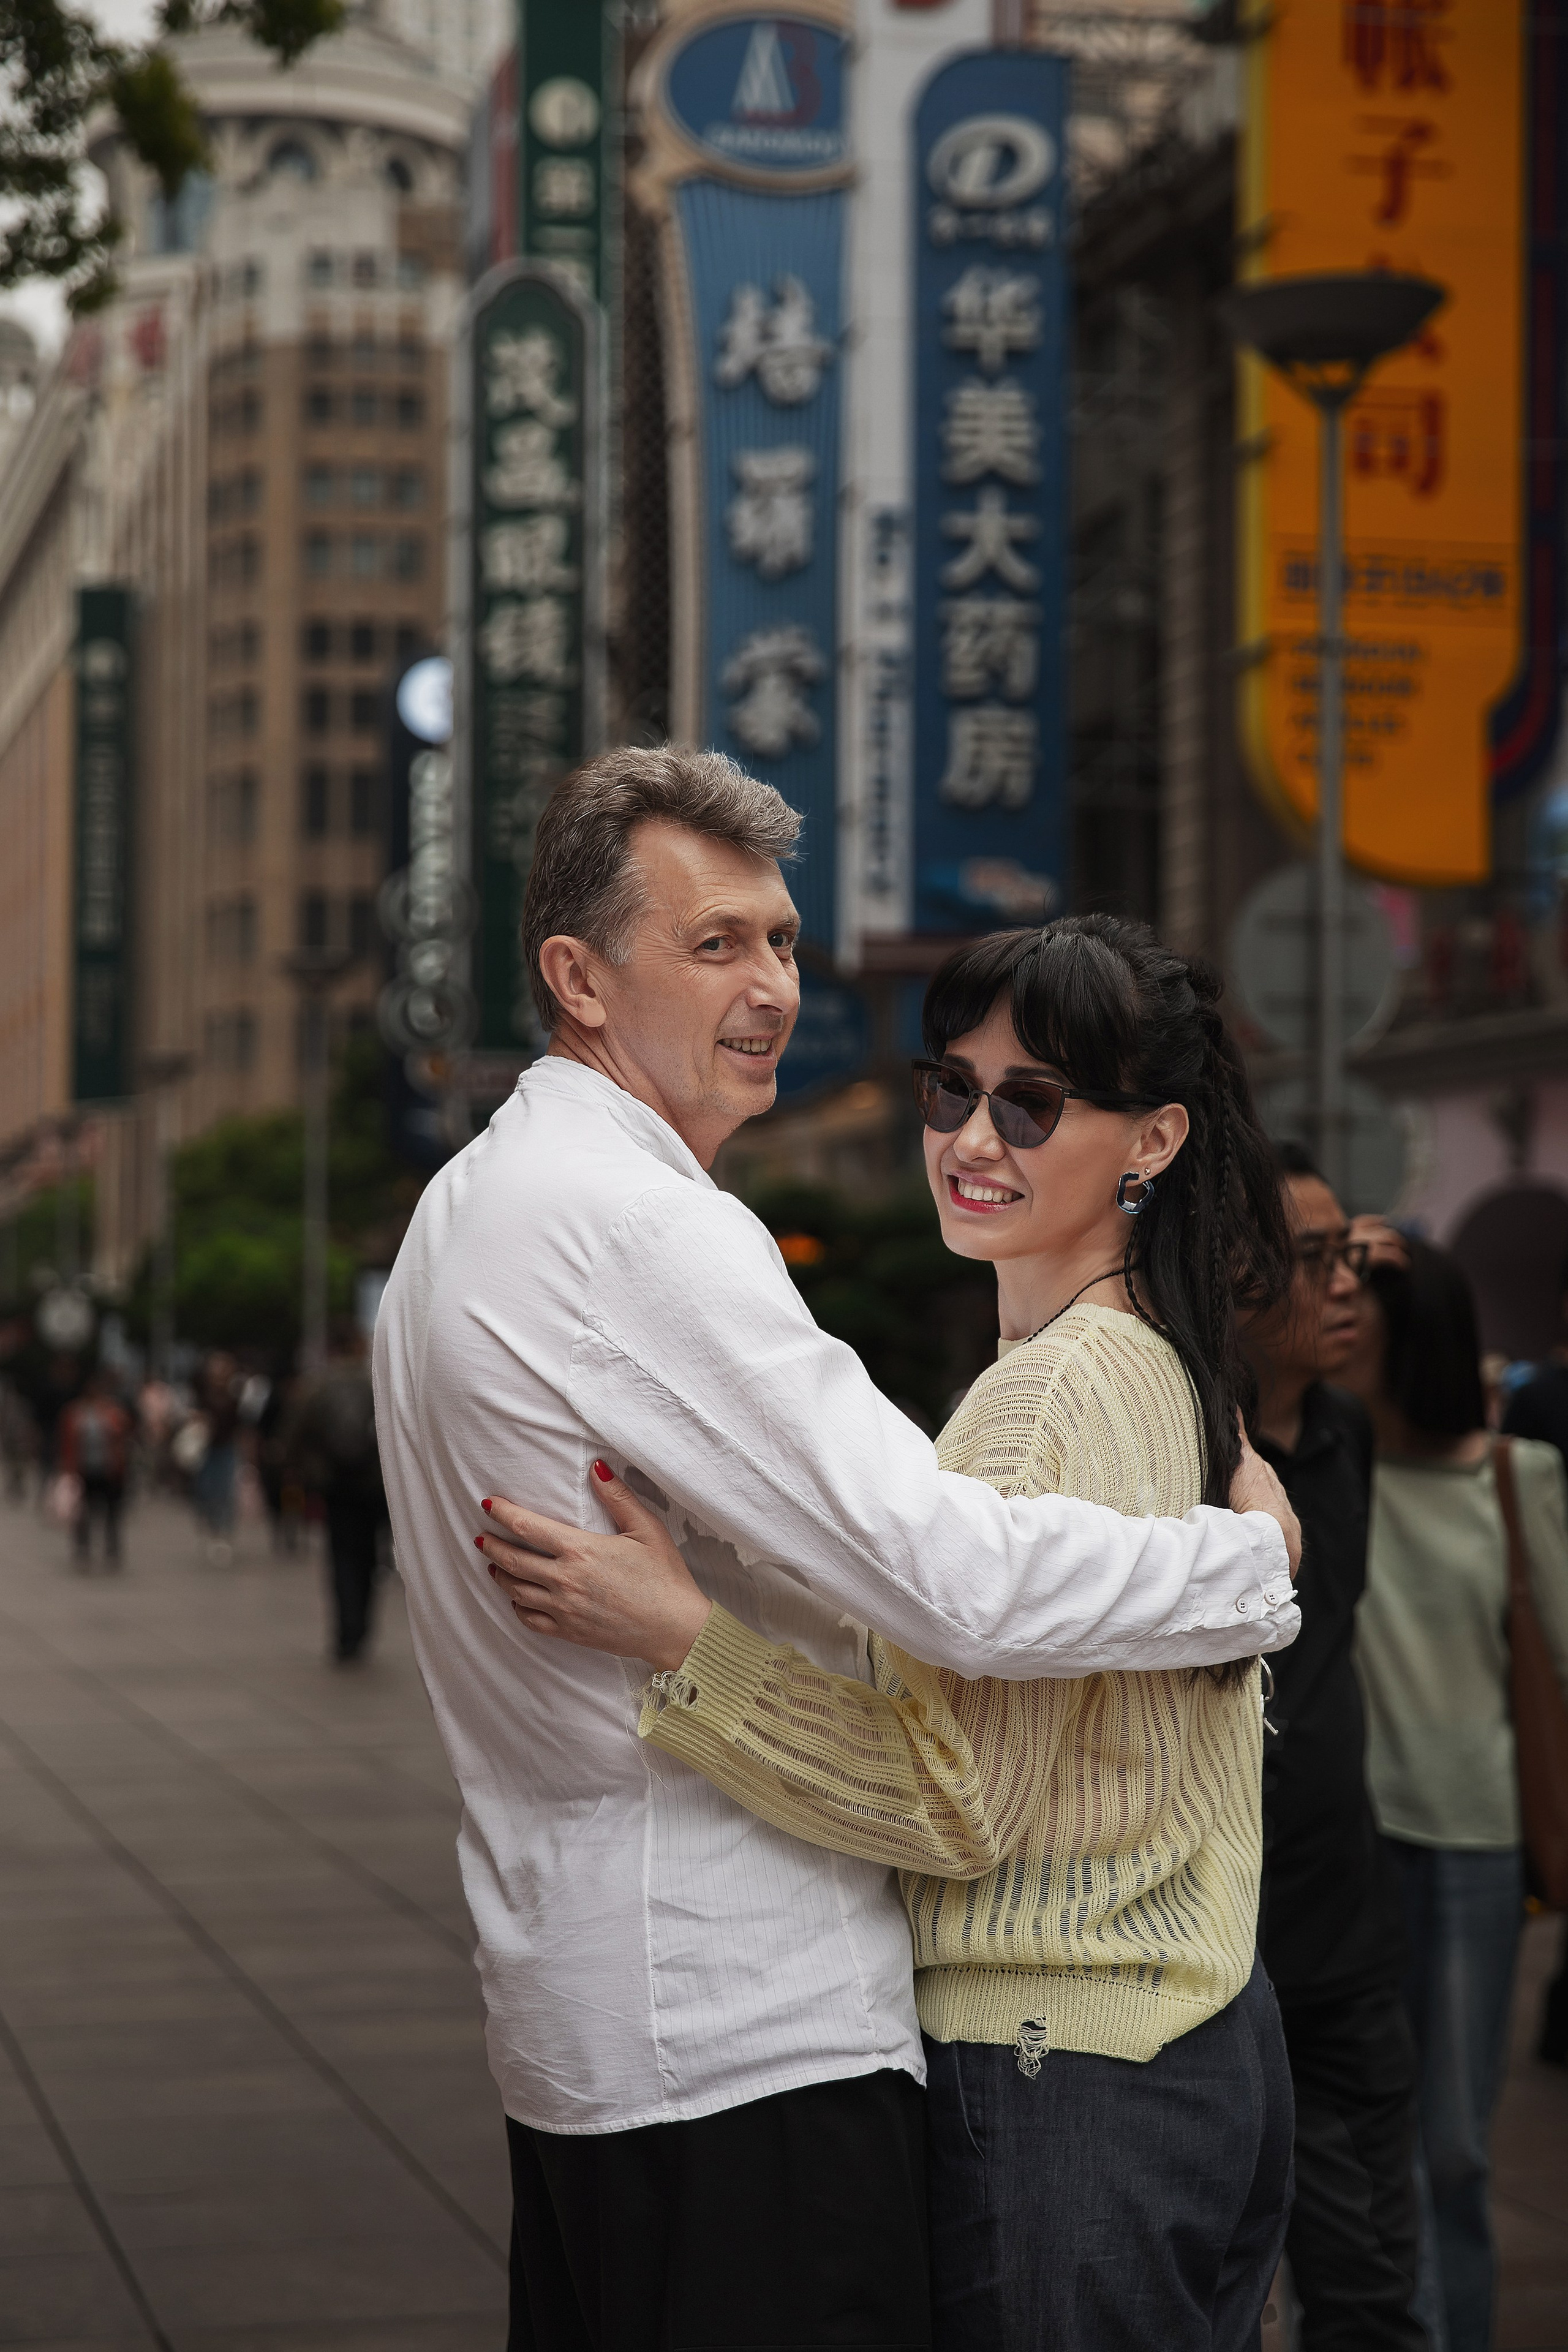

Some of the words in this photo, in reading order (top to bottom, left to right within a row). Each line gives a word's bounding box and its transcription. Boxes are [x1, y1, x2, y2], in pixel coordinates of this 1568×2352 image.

[941, 265, 1041, 810] 华美大药房
